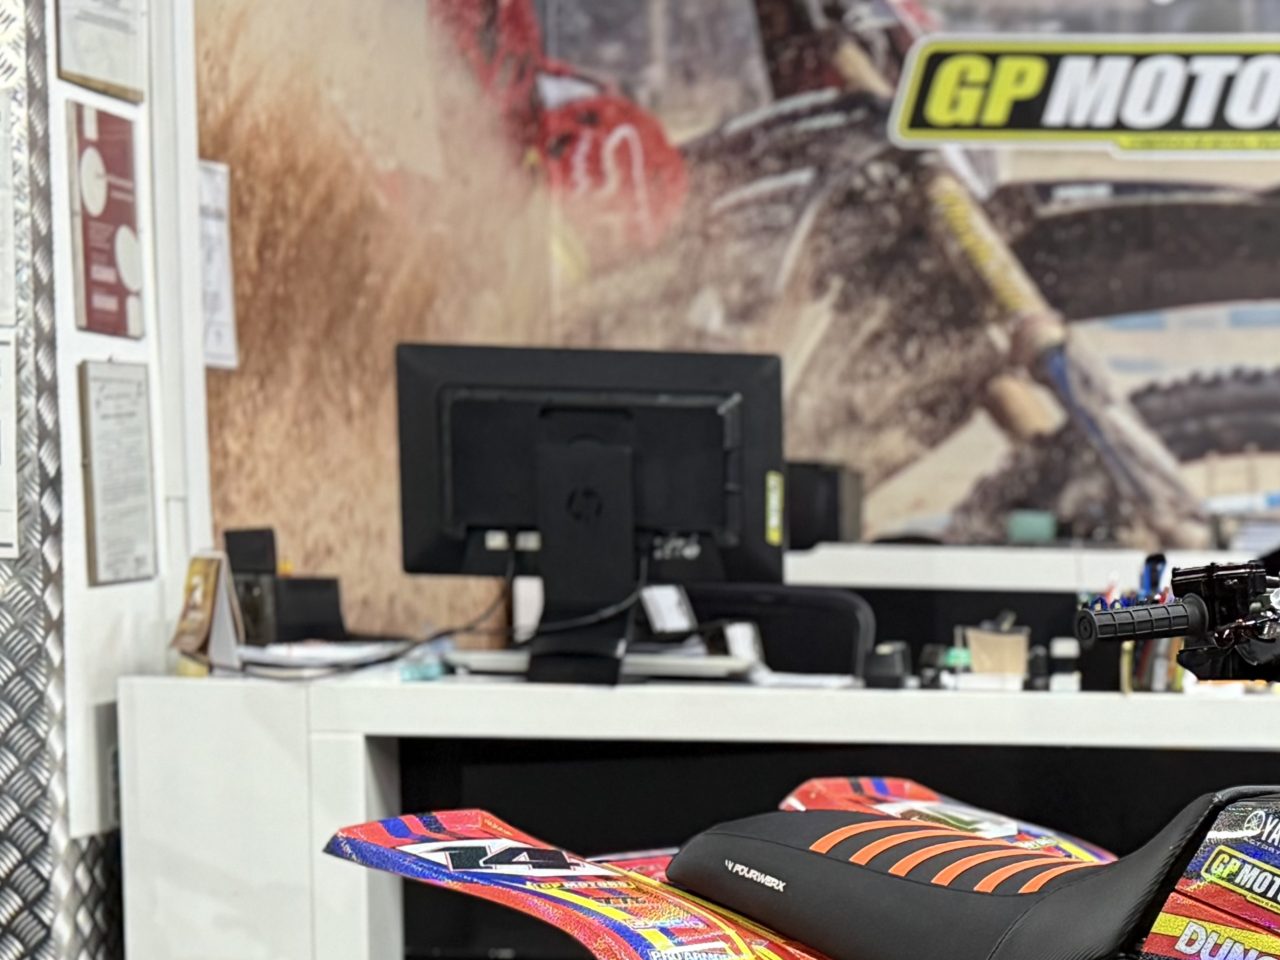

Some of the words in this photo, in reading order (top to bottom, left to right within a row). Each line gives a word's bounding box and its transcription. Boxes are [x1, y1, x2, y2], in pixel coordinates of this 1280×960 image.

[923, 53, 1049, 128] GP
[733, 863, 787, 893] FOURWERX
[1210, 853, 1241, 879] GP
